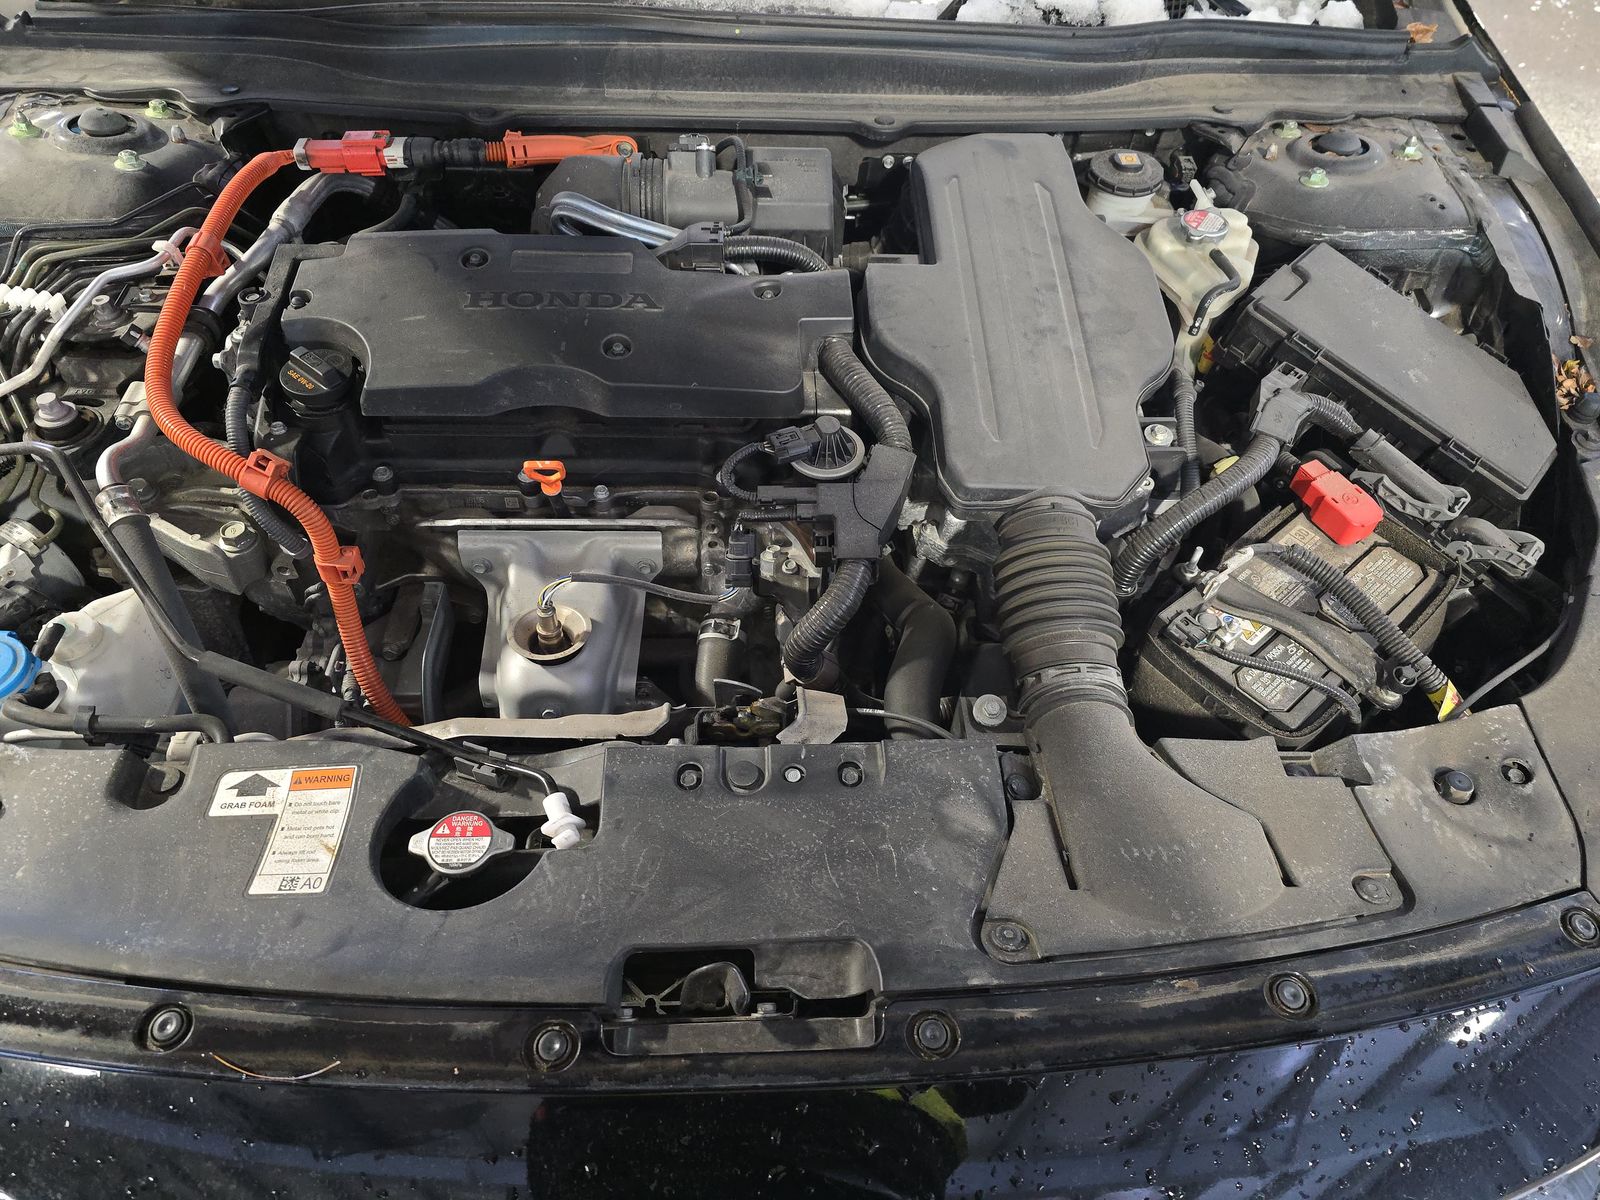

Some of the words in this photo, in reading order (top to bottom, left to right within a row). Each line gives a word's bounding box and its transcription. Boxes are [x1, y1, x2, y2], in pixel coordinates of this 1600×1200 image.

[463, 291, 664, 312] HONDA
[287, 369, 300, 380] SAE
[304, 774, 350, 784] WARNING
[220, 802, 246, 810] GRAB
